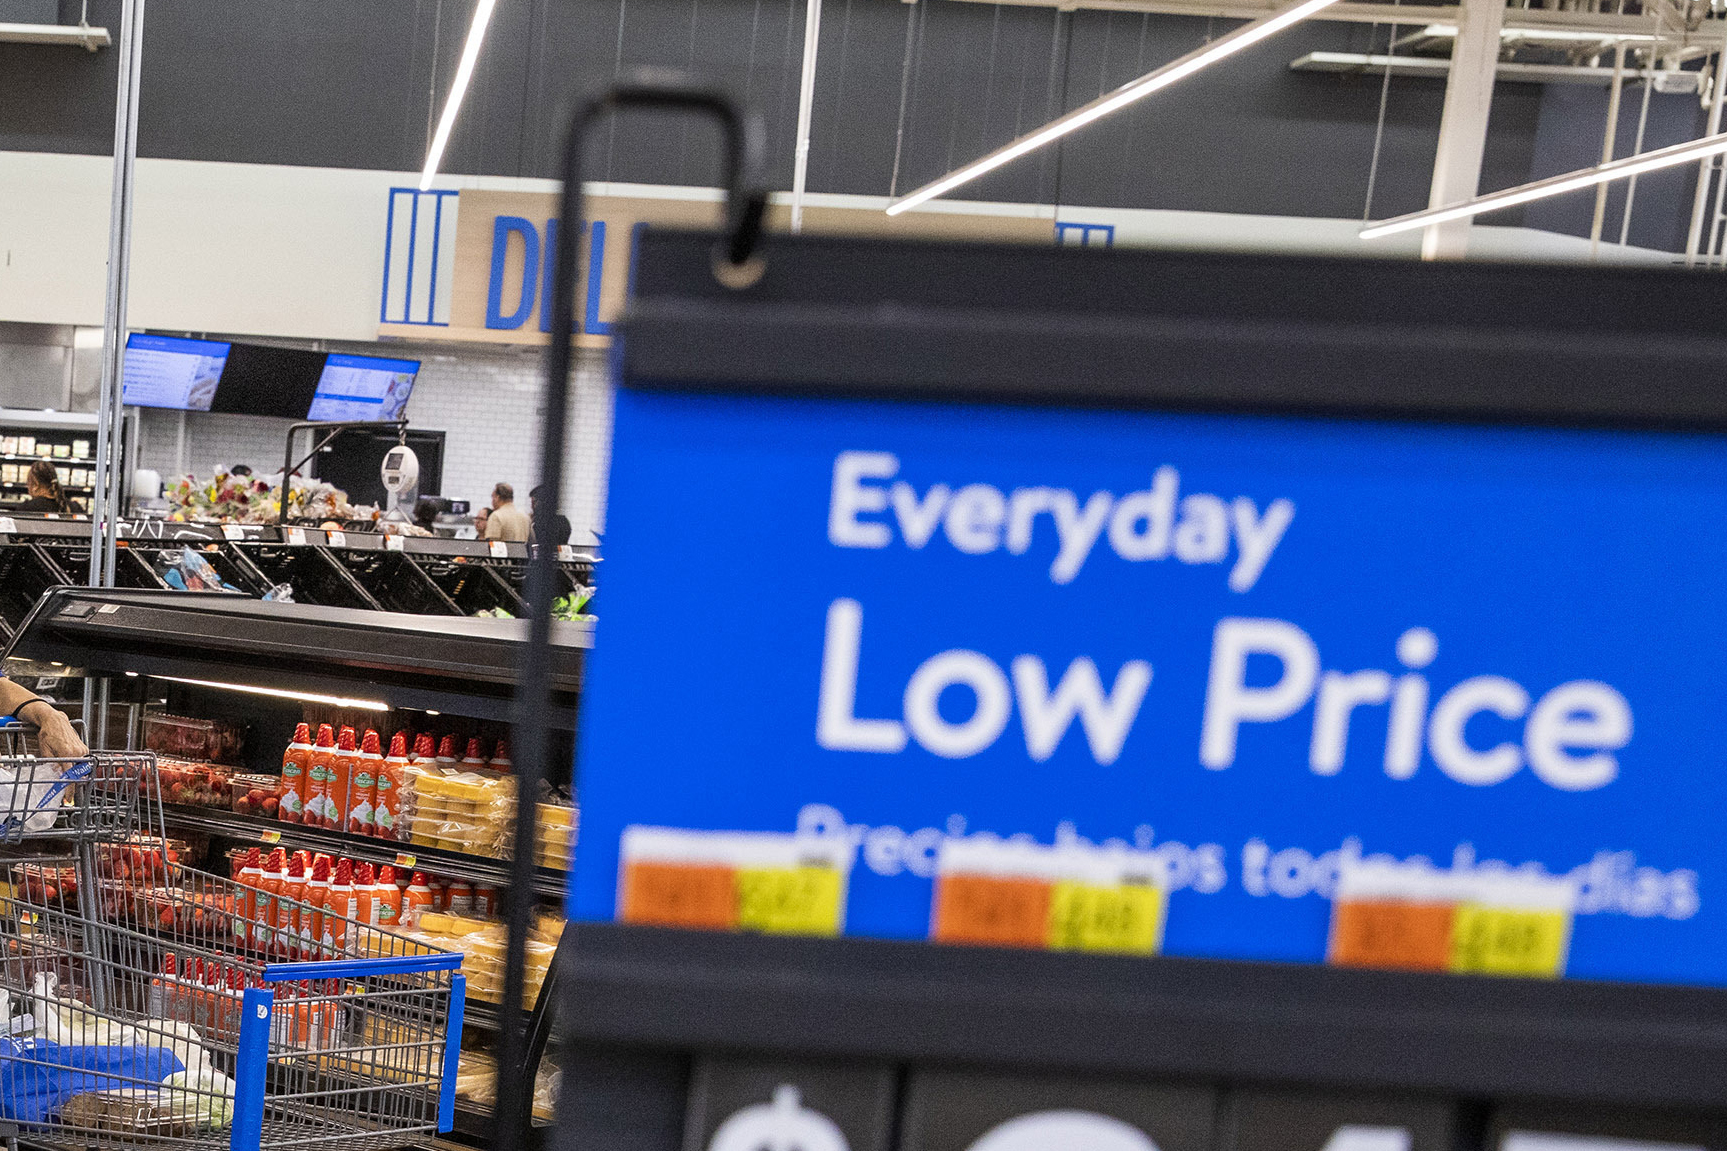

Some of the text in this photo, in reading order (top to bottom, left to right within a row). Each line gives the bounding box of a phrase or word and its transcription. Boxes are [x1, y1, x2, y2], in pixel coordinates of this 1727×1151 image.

[827, 450, 1295, 593] Everyday
[815, 598, 1634, 793] Low Price
